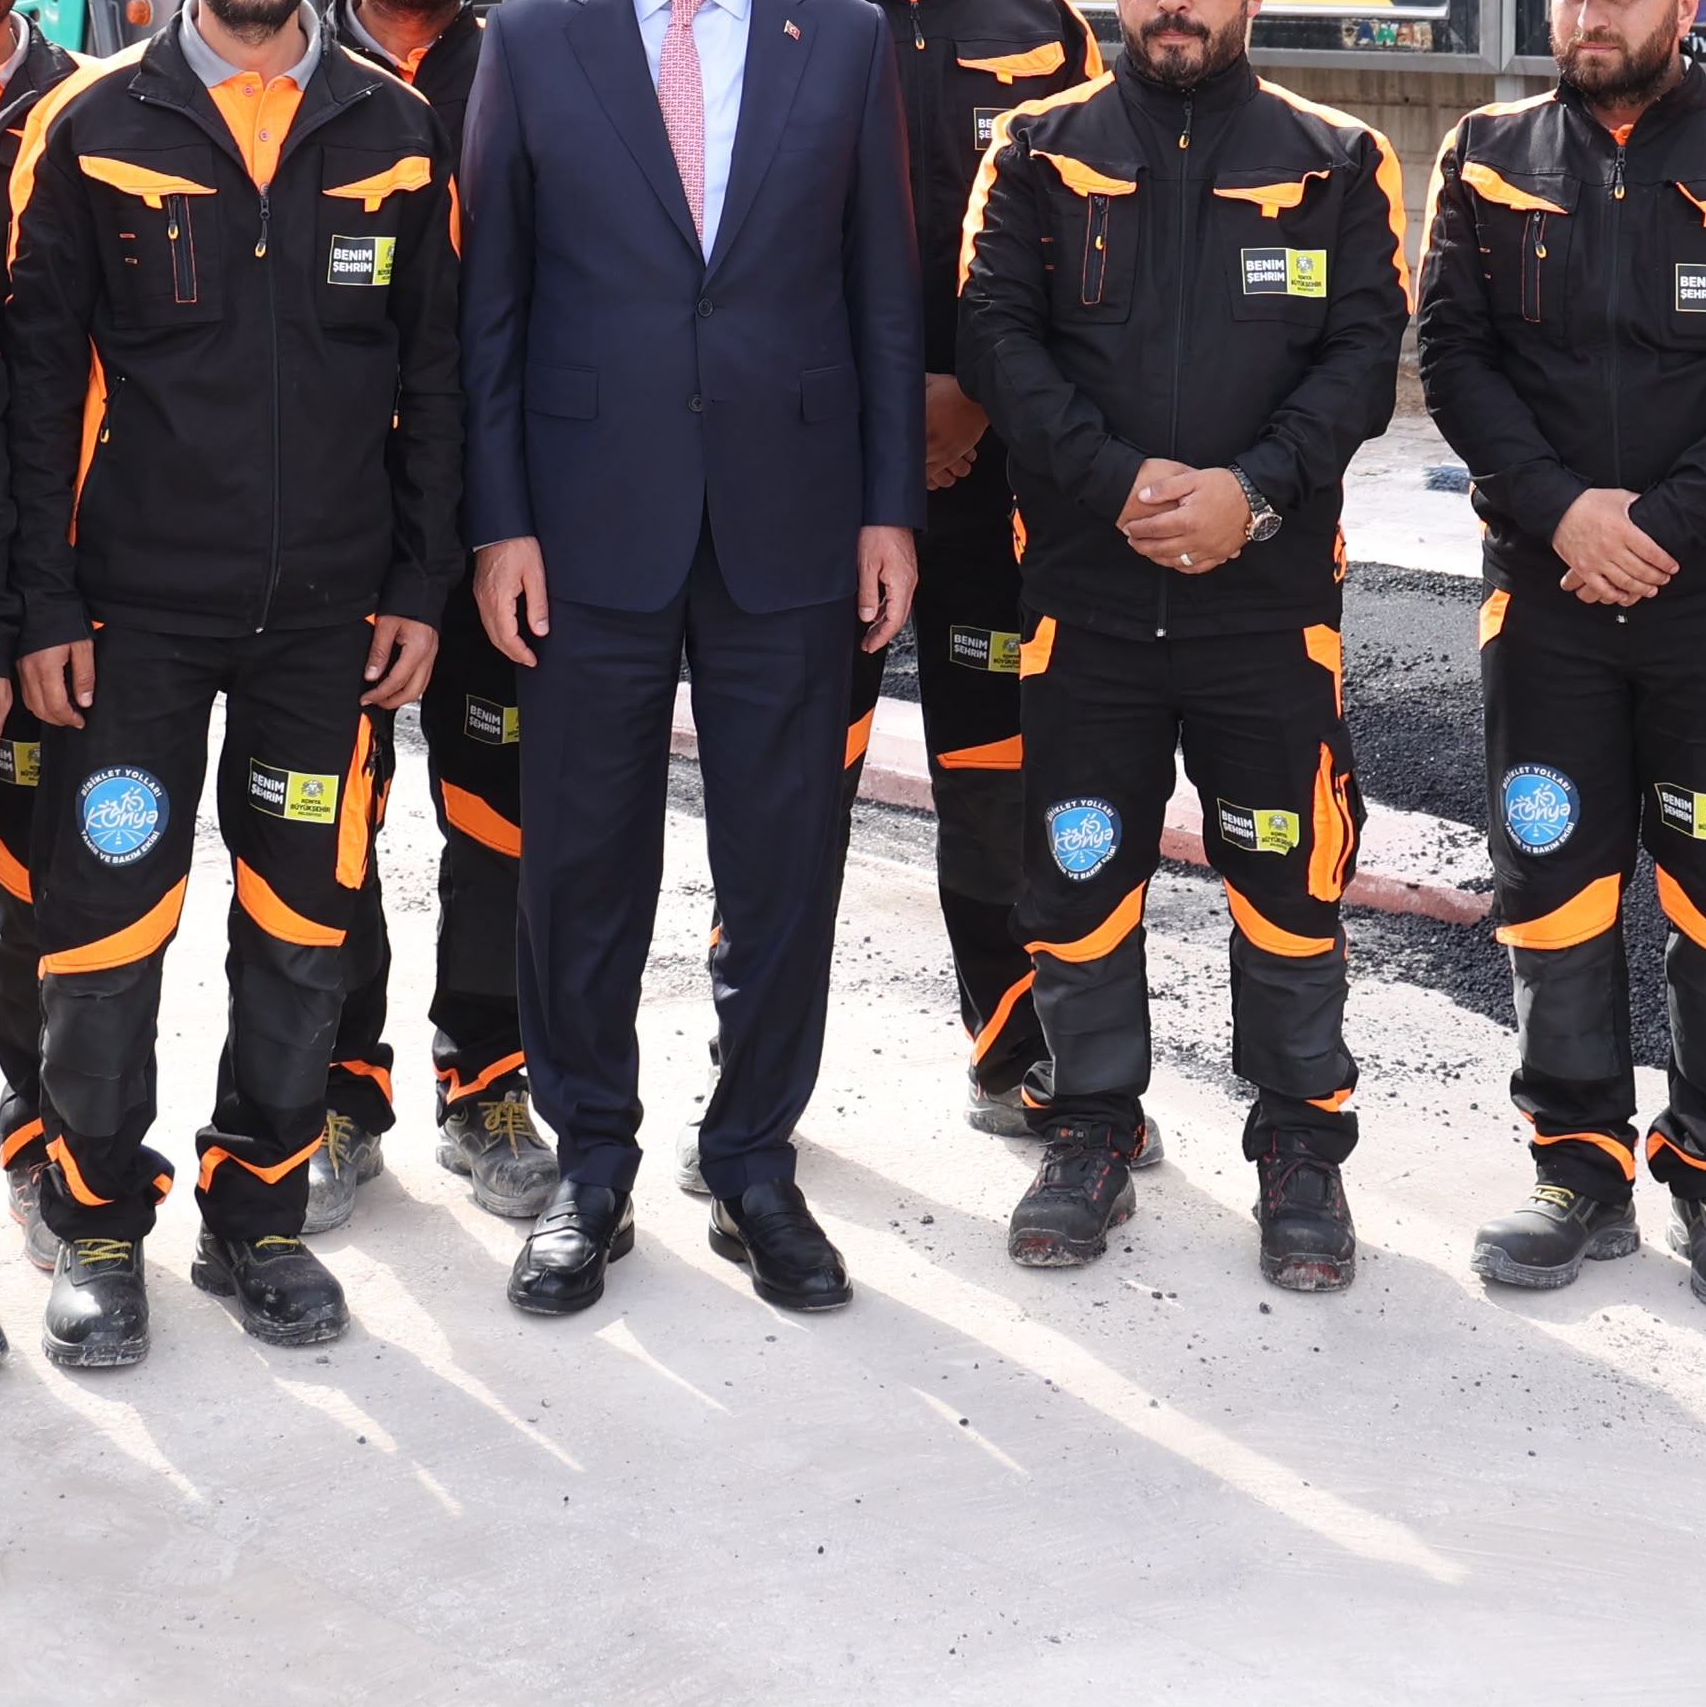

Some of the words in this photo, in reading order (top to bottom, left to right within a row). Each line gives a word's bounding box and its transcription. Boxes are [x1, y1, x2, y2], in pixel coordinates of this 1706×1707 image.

[333, 248, 372, 261] BENİM
[333, 261, 372, 273] ŞEHRİM
[1246, 259, 1284, 272] BENİM
[1247, 271, 1285, 284] ŞEHRİM
[954, 634, 988, 650] BENİM
[954, 644, 987, 659] ŞEHRİM
[470, 704, 501, 725] BENİM
[469, 716, 501, 735] ŞEHRİM
[80, 769, 121, 797] BİSİKLET
[125, 769, 162, 797] YOLLARI
[1533, 767, 1571, 791] YOLLARI
[251, 786, 284, 804] ŞEHRİM
[1662, 792, 1692, 812] BENİM
[1080, 799, 1114, 817] YOLLARI
[1664, 804, 1692, 824] ŞEHRİM
[1221, 810, 1253, 829] BENİM
[80, 829, 99, 855] TAMİR
[100, 852, 111, 863] VE
[112, 848, 141, 864] BAKIM
[141, 830, 161, 852] EKİBİ
[1532, 839, 1559, 853] BAKIM
[1559, 822, 1575, 842] EKİBİ
[1080, 862, 1102, 879] BAKIM
